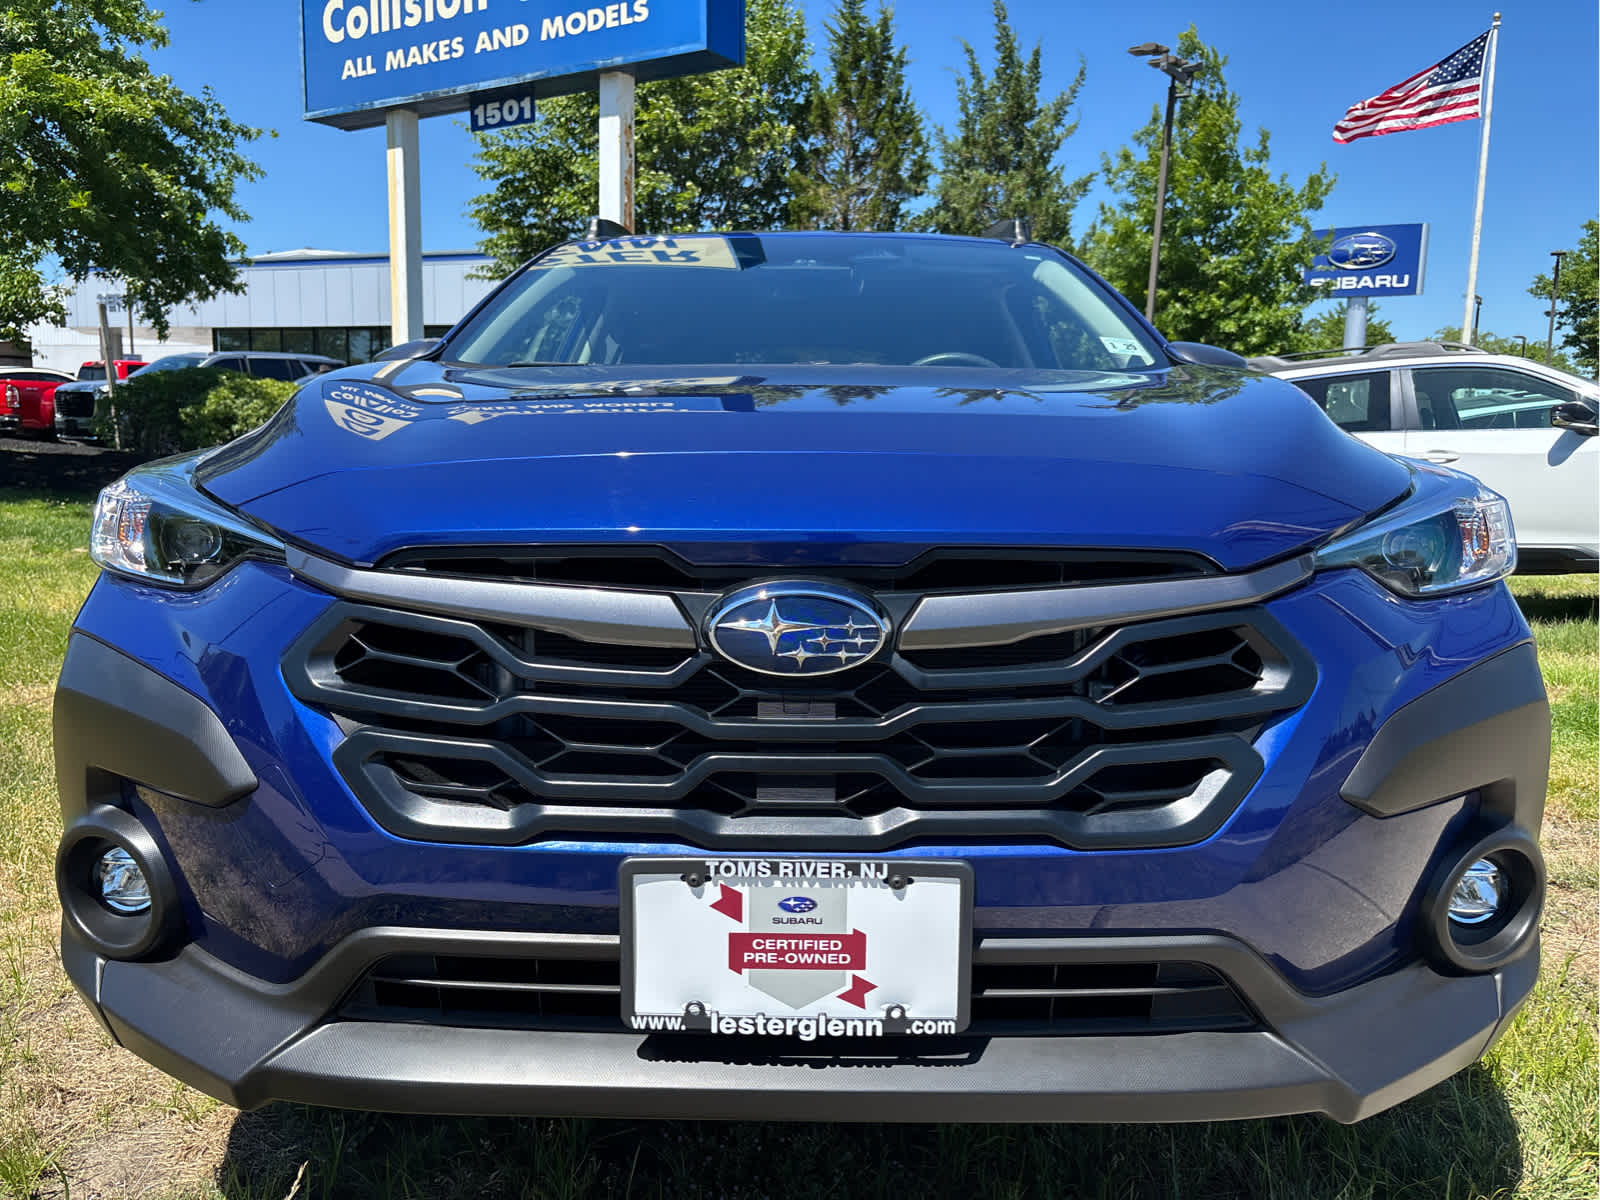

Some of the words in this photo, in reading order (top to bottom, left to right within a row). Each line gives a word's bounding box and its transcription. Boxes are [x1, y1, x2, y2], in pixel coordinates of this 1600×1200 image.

[322, 0, 488, 44] Collision
[341, 55, 377, 80] ALL
[385, 36, 465, 71] MAKES
[474, 24, 529, 54] AND
[540, 0, 649, 41] MODELS
[474, 96, 531, 127] 1501
[706, 861, 772, 878] TOMS
[779, 862, 853, 880] RIVER,
[860, 863, 889, 880] NJ
[772, 916, 824, 925] SUBARU
[752, 939, 842, 951] CERTIFIED
[743, 952, 851, 964] PRE-OWNED
[631, 1015, 687, 1031] www.
[710, 1011, 883, 1042] lesterglenn
[905, 1020, 956, 1035] .com
